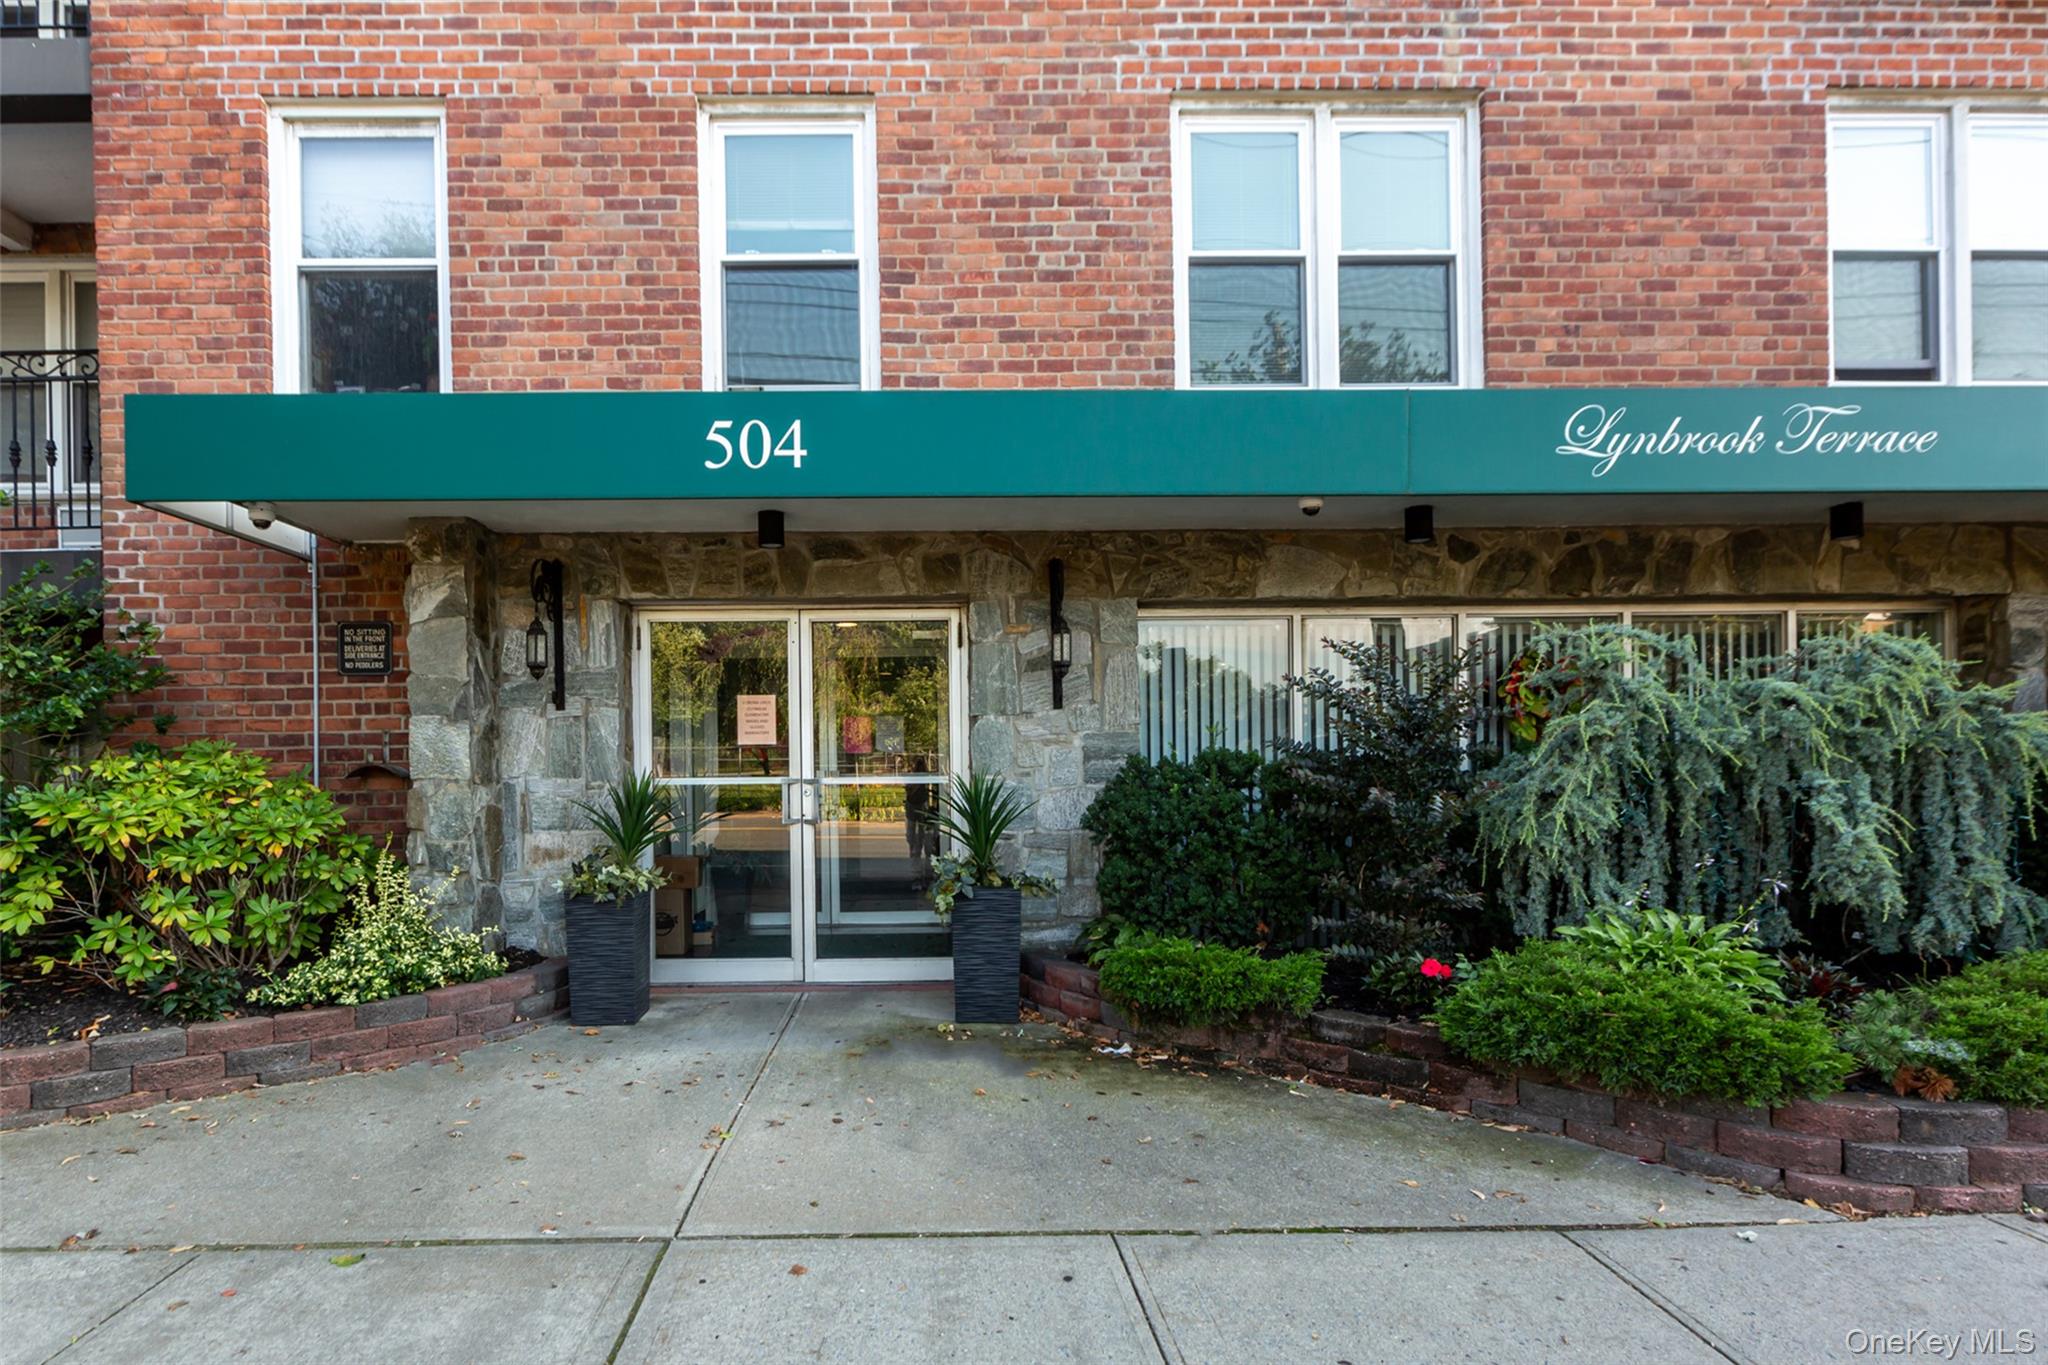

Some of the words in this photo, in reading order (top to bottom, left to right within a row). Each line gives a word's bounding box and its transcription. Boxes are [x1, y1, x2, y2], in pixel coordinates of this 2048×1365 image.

[704, 418, 808, 469] 504
[1555, 403, 1767, 478] Lynbrook
[1775, 403, 1939, 455] Terrace
